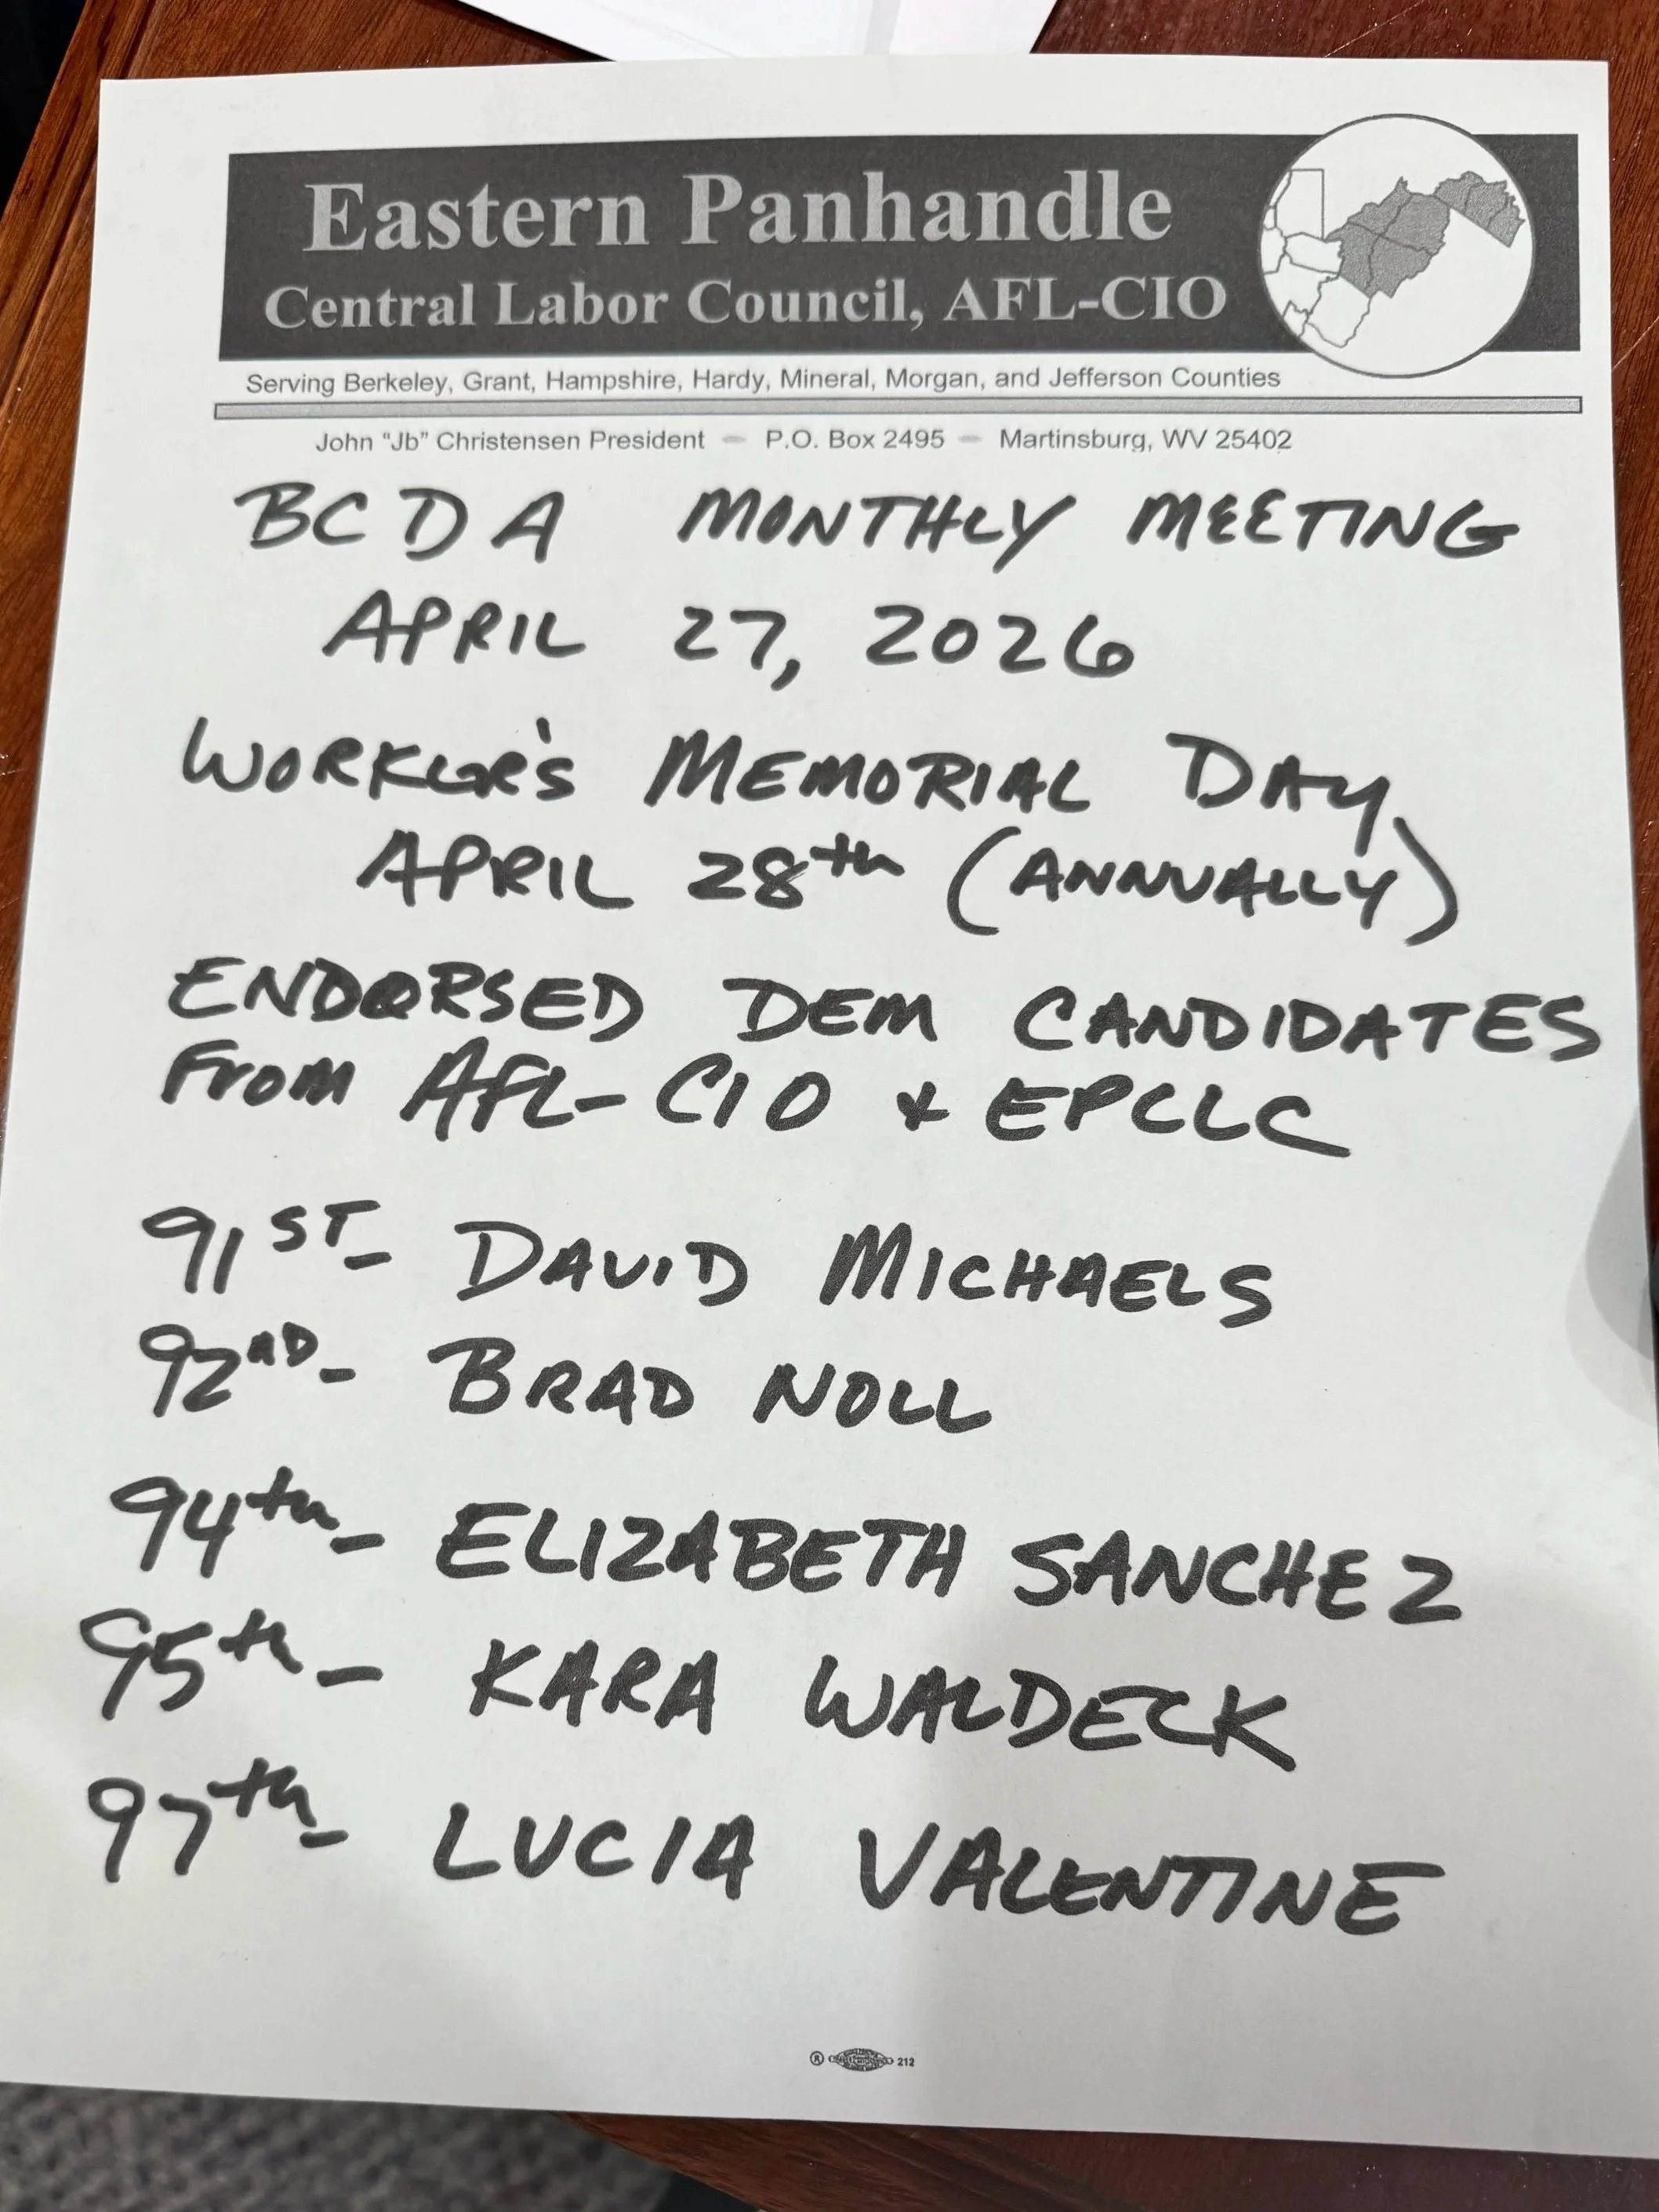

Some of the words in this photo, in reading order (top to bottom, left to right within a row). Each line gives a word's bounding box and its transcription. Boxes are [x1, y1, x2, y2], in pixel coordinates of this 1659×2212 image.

[302, 183, 650, 252] Eastern
[681, 169, 1172, 245] Panhandle
[265, 282, 476, 329] Central
[496, 280, 670, 325] Labor
[688, 277, 924, 332] Council,
[942, 275, 1227, 321] AFL-CIO
[245, 373, 336, 398] Serving
[343, 372, 453, 397] Berkeley,
[463, 371, 535, 393] Grant,
[546, 369, 682, 394] Hampshire,
[693, 369, 771, 394] Hardy,
[780, 368, 876, 390] Mineral,
[886, 368, 986, 393] Morgan,
[995, 367, 1040, 387] and
[1048, 367, 1162, 387] Jefferson
[1171, 367, 1281, 387] Counties
[315, 432, 373, 452] John
[436, 431, 580, 452] Christensen
[590, 430, 706, 451] President
[766, 429, 819, 449] P.O.
[829, 428, 876, 449] Box
[882, 429, 946, 449] 2495
[1000, 428, 1153, 453] Martinsburg,
[1162, 429, 1208, 449] WV
[1215, 429, 1292, 450] 25402
[677, 486, 1076, 571] MONTHLY
[1127, 487, 1520, 558] MEETING
[321, 588, 584, 664] APRIL
[673, 605, 800, 690] 27,
[866, 603, 1135, 677] 2026
[643, 728, 1091, 814] MEMORIAL
[1166, 731, 1391, 857] DAY
[355, 828, 634, 910] APRIL
[946, 815, 1459, 946] (ANNUALLY)
[721, 976, 938, 1044] DEM
[1013, 984, 1602, 1063] CANDIDATES
[985, 1073, 1351, 1159] EPCLC
[453, 1219, 749, 1309] DAVID
[819, 1221, 1272, 1330] MICHAELS
[427, 1335, 695, 1427] BRAD
[752, 1361, 993, 1435] NOLL
[435, 1501, 967, 1599] ELIZABETH
[1011, 1528, 1463, 1626] SANCHEZ
[468, 1637, 719, 1736] KARA
[804, 1653, 1298, 1774] WALDECK
[432, 1801, 755, 1901] LUCIA
[858, 1821, 1447, 1938] VALENTINE
[897, 2056, 916, 2068] 212
